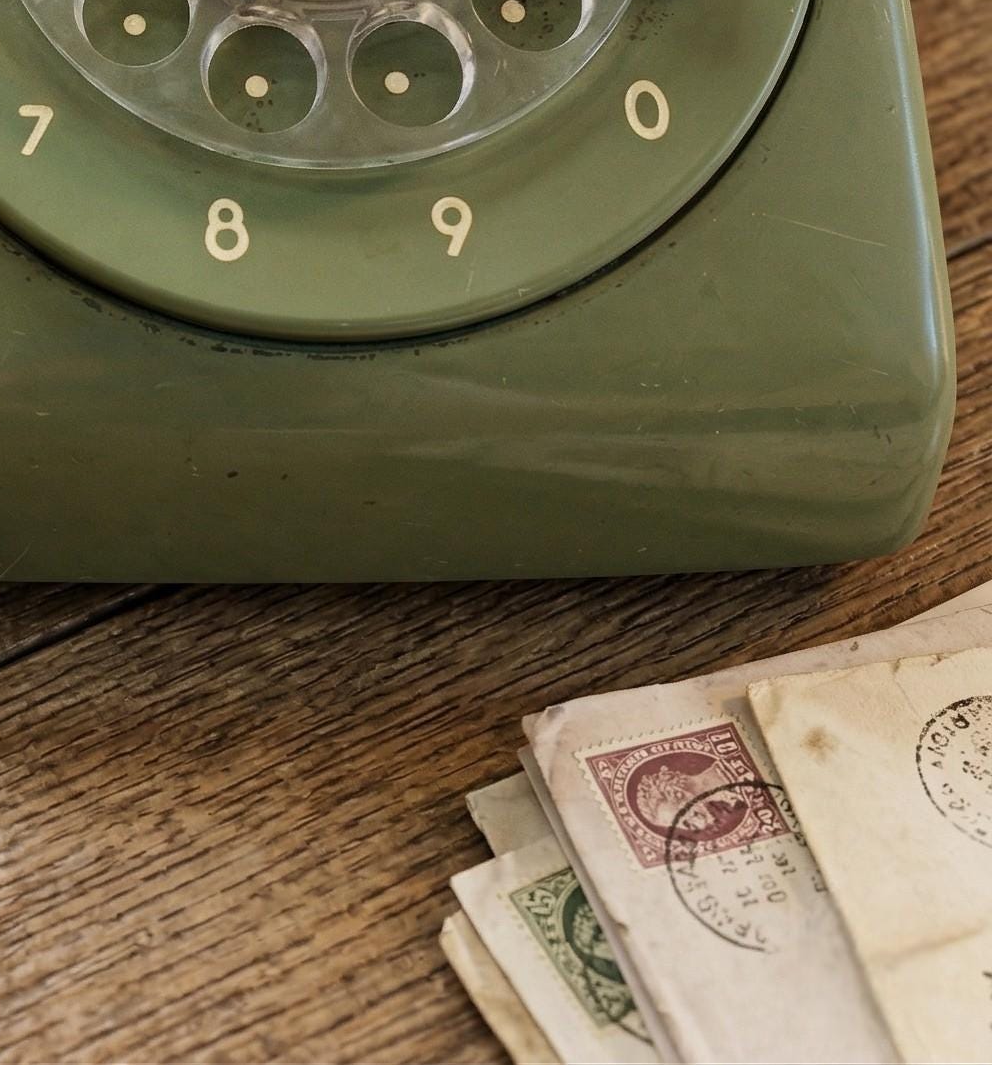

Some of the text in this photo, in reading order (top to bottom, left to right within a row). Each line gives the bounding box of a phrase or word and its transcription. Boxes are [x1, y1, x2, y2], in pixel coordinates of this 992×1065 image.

[18, 104, 54, 156] 7
[624, 80, 670, 140] 0
[204, 198, 250, 262] 8
[431, 196, 473, 257] 9
